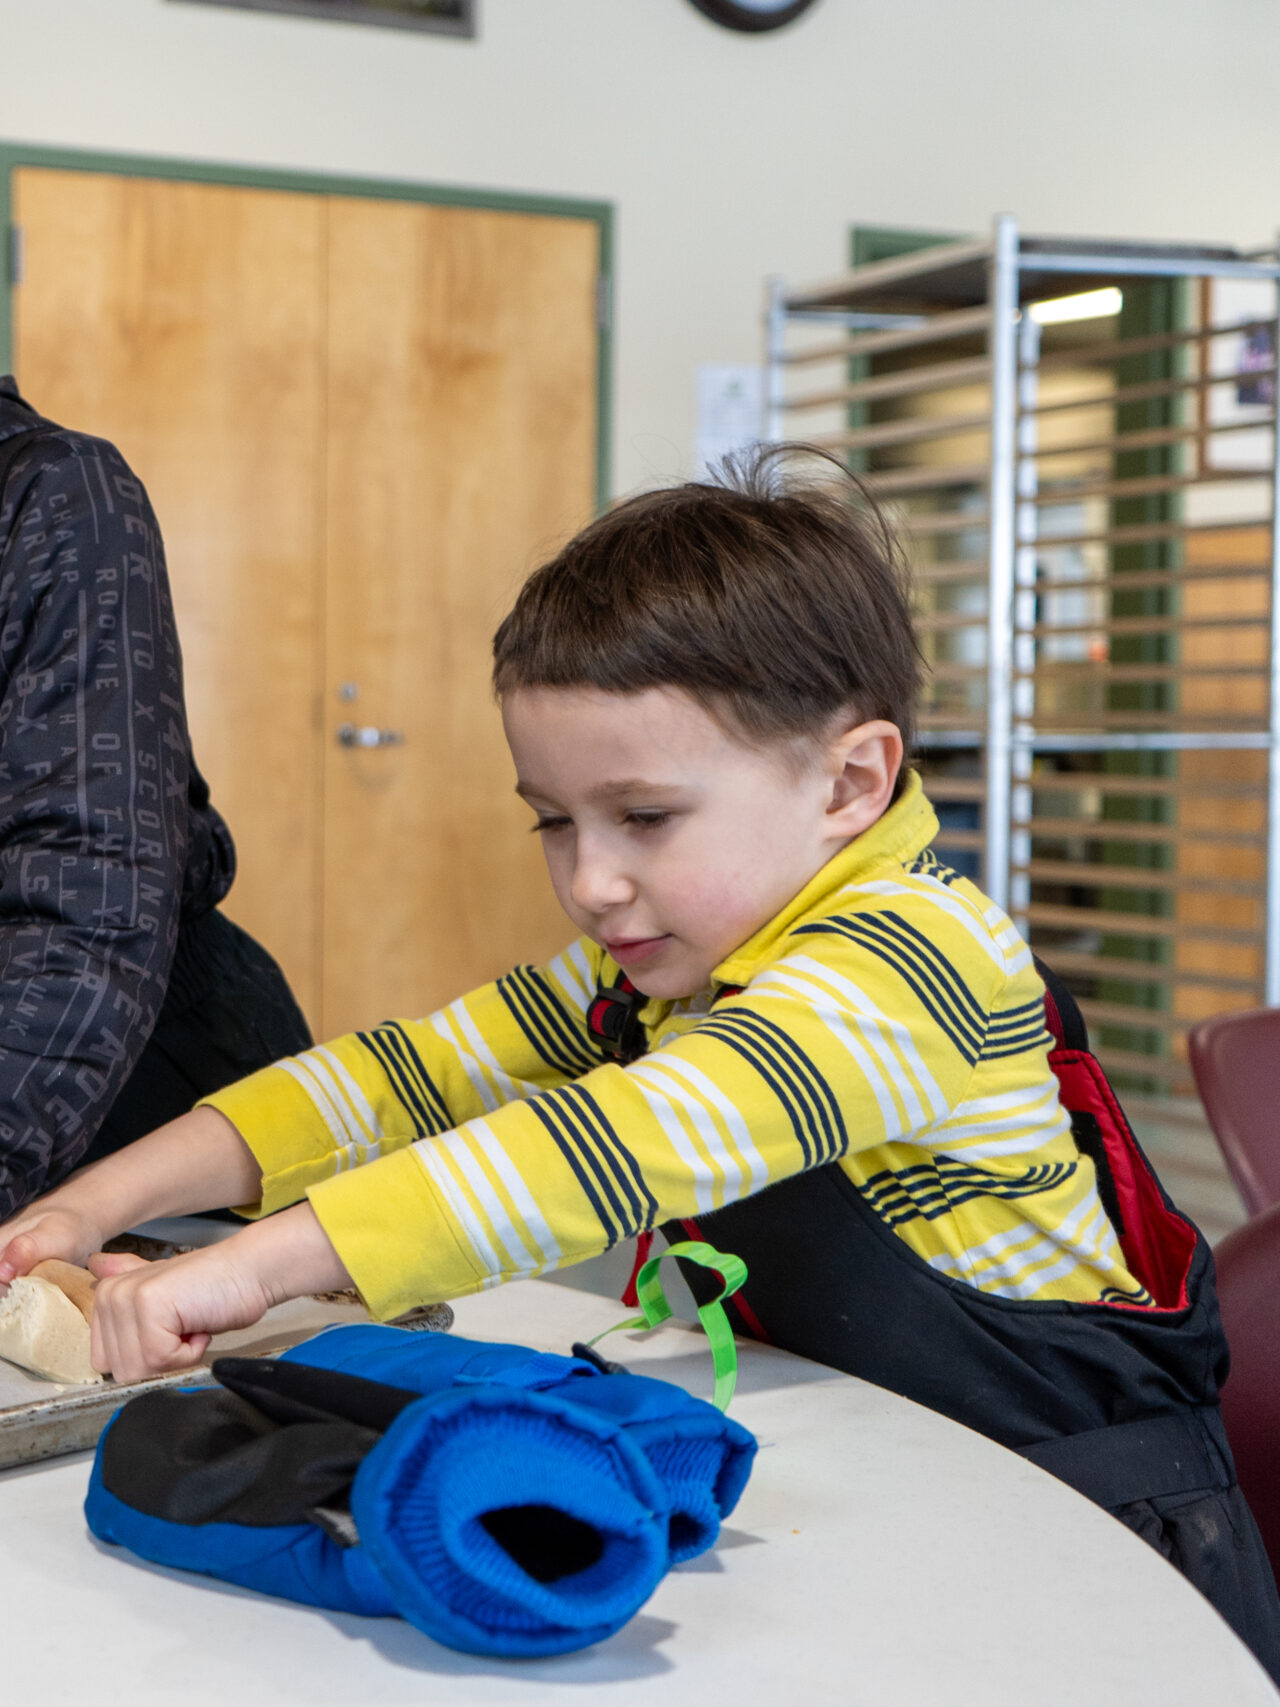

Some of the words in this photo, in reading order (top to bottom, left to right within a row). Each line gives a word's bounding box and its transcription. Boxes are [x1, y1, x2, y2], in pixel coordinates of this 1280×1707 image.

[47, 492, 79, 582] CHAMP
[95, 568, 119, 689] ROOKIE
[91, 732, 121, 775] OF
[137, 749, 164, 933] SCORING
